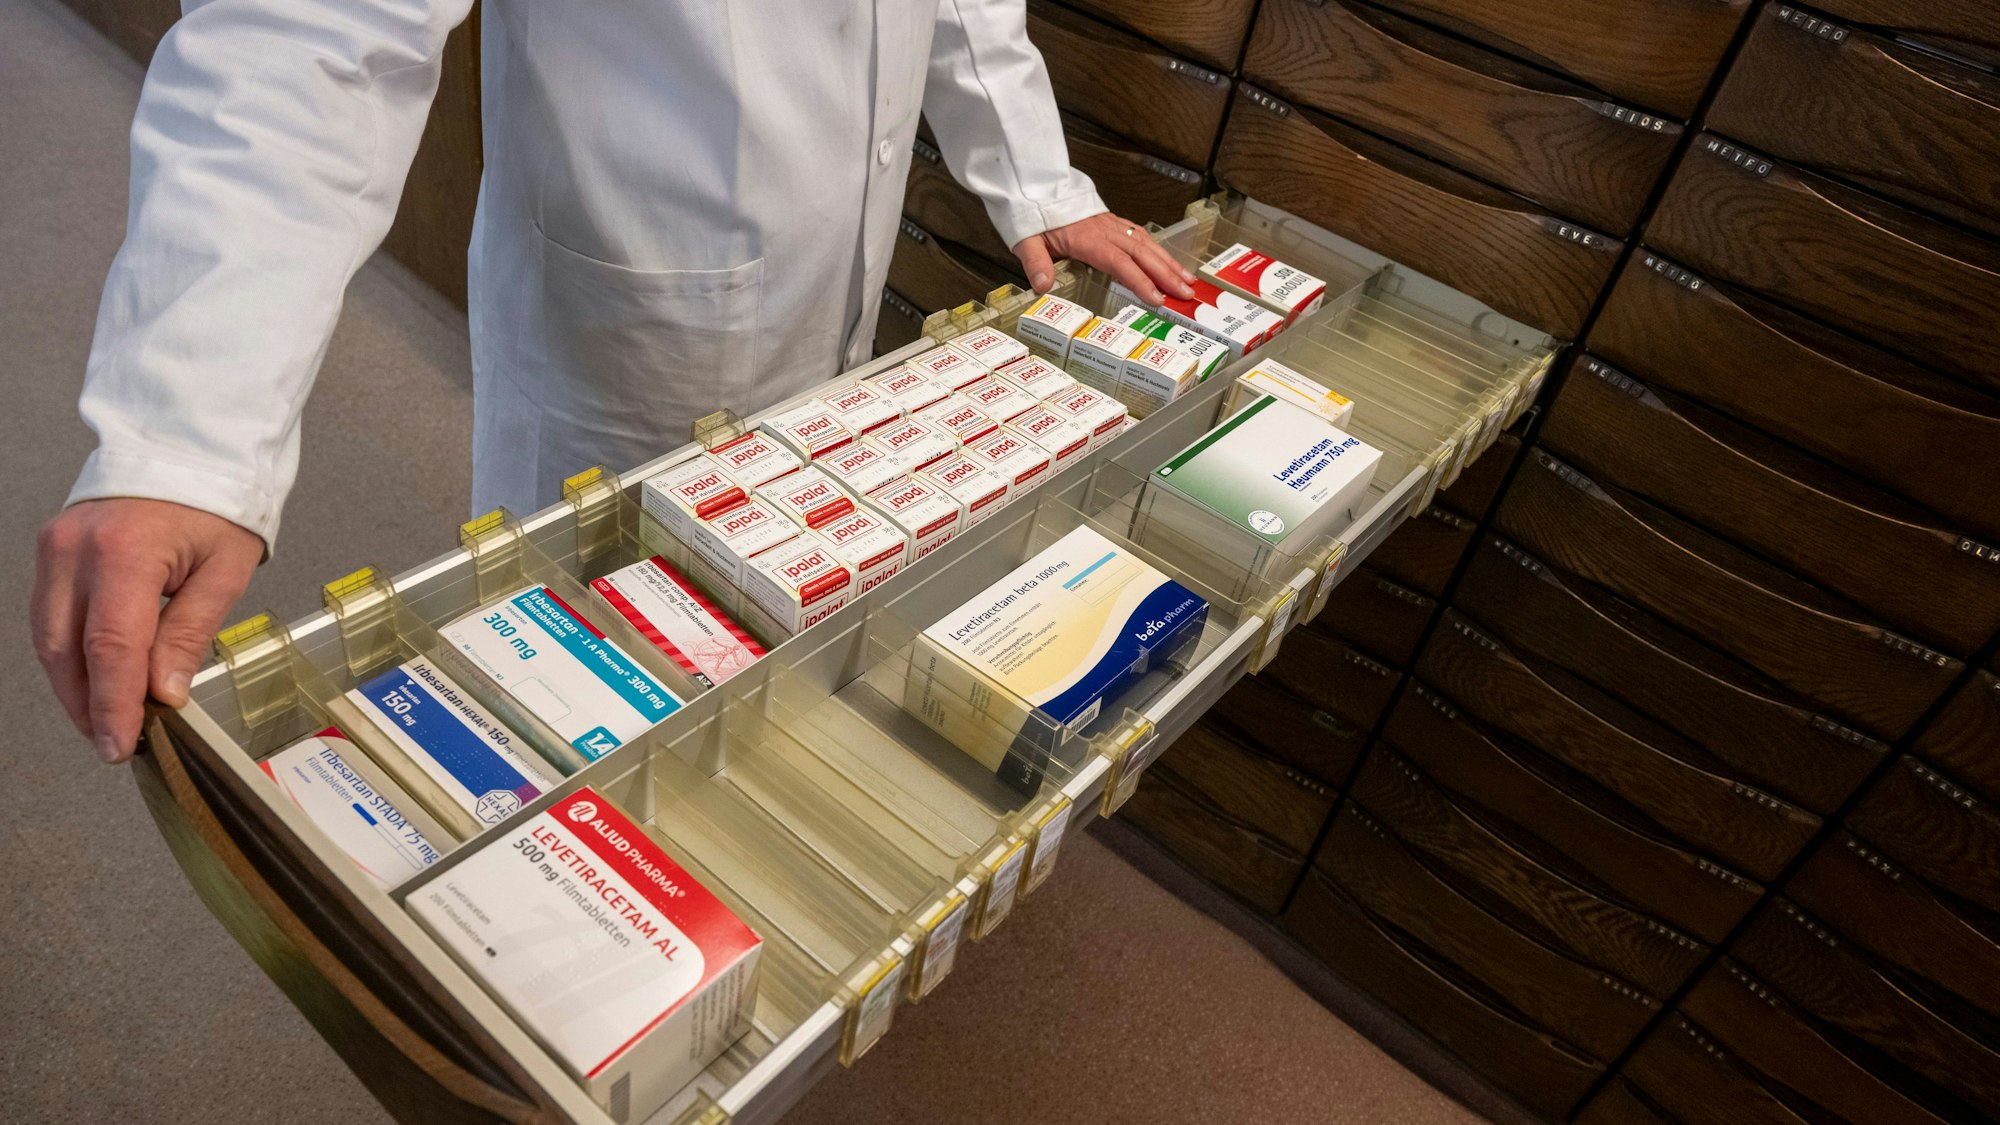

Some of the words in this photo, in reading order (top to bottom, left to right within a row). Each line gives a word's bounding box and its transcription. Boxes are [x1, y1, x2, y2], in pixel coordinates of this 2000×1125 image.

[1779, 8, 1844, 41] METFO
[1708, 141, 1768, 174] METFO
[1644, 256, 1700, 289] METFO
[1044, 303, 1063, 321] ipalat
[972, 335, 1000, 350] ipalat
[930, 355, 960, 371] ipalat
[1149, 346, 1168, 366] ipalat
[888, 374, 920, 391] ipalat
[1019, 365, 1047, 381] ipalat
[837, 391, 871, 409] ipalat
[979, 386, 1009, 403] ipalat
[1067, 394, 1097, 412] ipalat
[794, 417, 832, 437] ipalat
[945, 408, 977, 428] ipalat
[1028, 415, 1060, 434] ipalat
[888, 427, 924, 447] ipalat
[986, 440, 1020, 459] ipalat
[731, 443, 771, 466] ipalat
[840, 450, 878, 471] ipalat
[1273, 436, 1334, 483] Levetiracetam
[1287, 455, 1330, 490] Heumann
[1324, 445, 1345, 462] 750
[1342, 437, 1360, 452] mg
[678, 473, 722, 496] ipalat
[942, 463, 978, 484] ipalat
[788, 484, 830, 506] ipalat
[889, 486, 928, 509] ipalat
[722, 510, 765, 533] ipalat
[831, 518, 874, 542] ipalat
[781, 552, 827, 578] ipalat
[644, 561, 673, 587] Irbesartan
[671, 585, 689, 602] comp.
[861, 565, 900, 596] ipalat
[804, 597, 845, 629] ipalat
[948, 594, 1018, 641] Levetiracetam
[1013, 579, 1038, 596] beta
[1036, 566, 1058, 582] 1000
[1164, 598, 1194, 624] pharm
[519, 597, 567, 639] Filmtabletten
[676, 602, 714, 637] Filmtabletten
[483, 612, 517, 639] 300
[510, 637, 537, 661] mg
[529, 592, 577, 635] Irbesartan
[589, 641, 597, 651] A
[627, 674, 651, 694] 300
[647, 692, 666, 710] mg
[1884, 635, 1948, 666] OLMES
[381, 690, 412, 715] 150
[402, 714, 416, 727] mg
[413, 664, 463, 707] Irbesartan
[487, 727, 510, 746] 150
[503, 744, 513, 754] mg
[305, 756, 353, 802] Filmtabletten
[319, 748, 374, 800] Irbesartan
[404, 827, 420, 846] 75
[417, 843, 440, 864] mg
[484, 796, 508, 818] HEXAL
[589, 818, 631, 853] ALIUD
[445, 882, 491, 926] Levetiracetam
[512, 837, 546, 865] 500
[538, 861, 560, 883] mg
[556, 877, 631, 949] Filmtabletten
[531, 825, 658, 939] LEVETIRACETAM
[653, 937, 680, 963] AL
